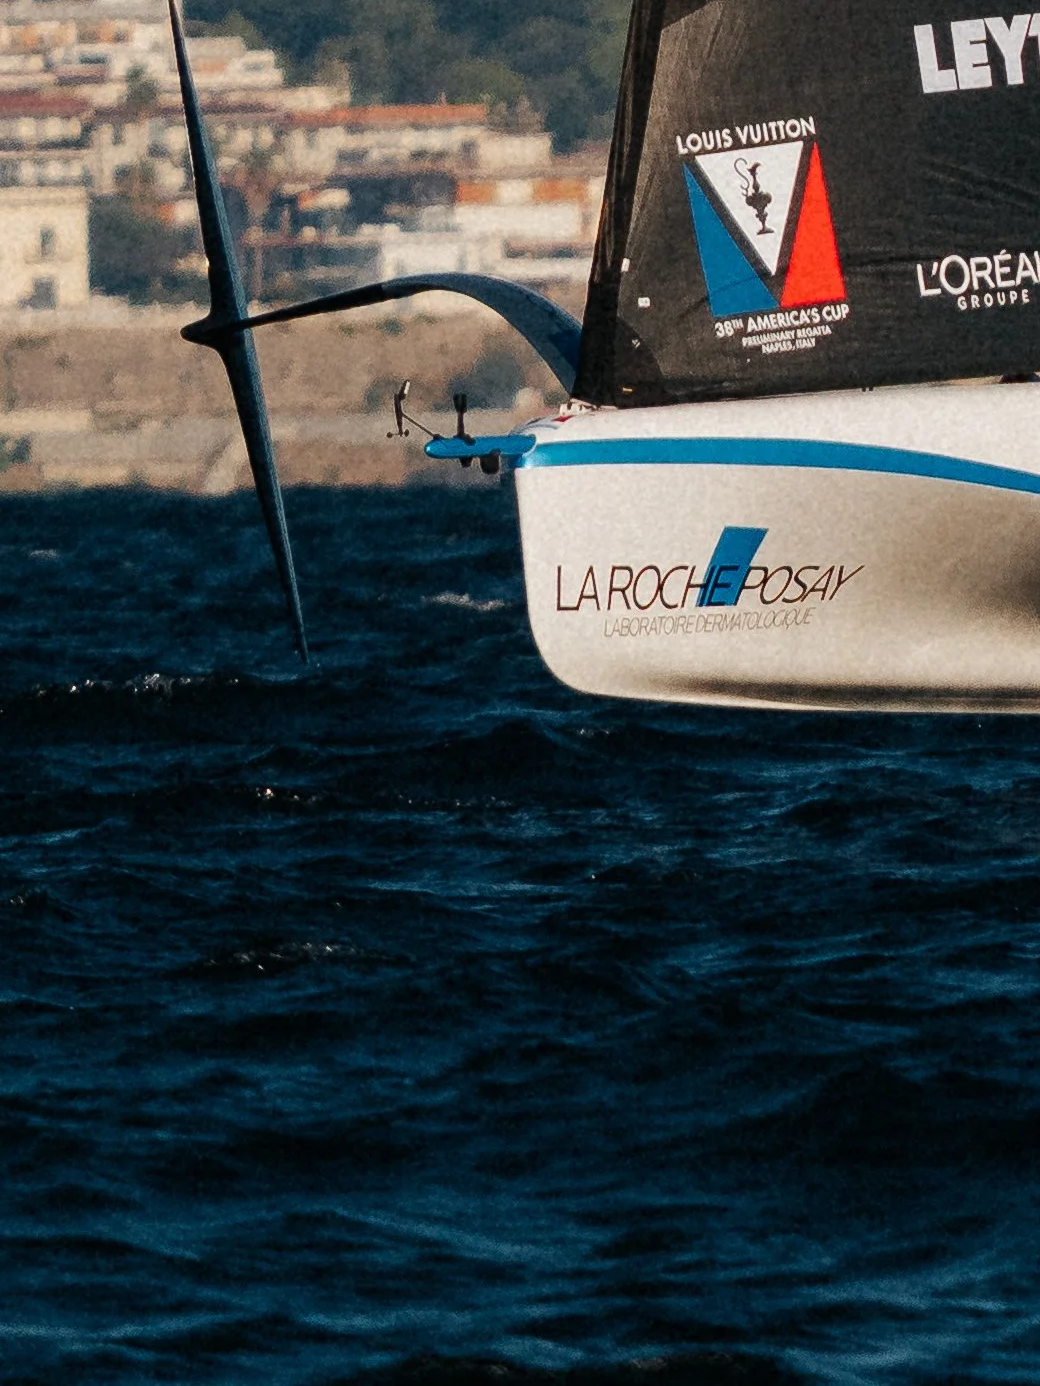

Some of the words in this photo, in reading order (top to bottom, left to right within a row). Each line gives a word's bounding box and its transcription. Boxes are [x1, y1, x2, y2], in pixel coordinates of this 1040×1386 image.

[676, 127, 734, 155] LOUIS
[735, 115, 817, 146] VUITTON
[957, 289, 1031, 311] GROUPE
[714, 318, 744, 339] 38TH
[746, 306, 820, 334] AMERICA'S
[821, 303, 850, 322] CUP
[741, 330, 796, 348] PRELIMINARY
[796, 324, 832, 340] REGATTA
[795, 337, 816, 351] ITALY
[556, 565, 601, 611] LA
[606, 565, 740, 611] ROCHE
[731, 564, 866, 606] POSAY
[603, 615, 695, 637] LABORATOIRE
[695, 606, 816, 633] DERMATOLOGIQUE
